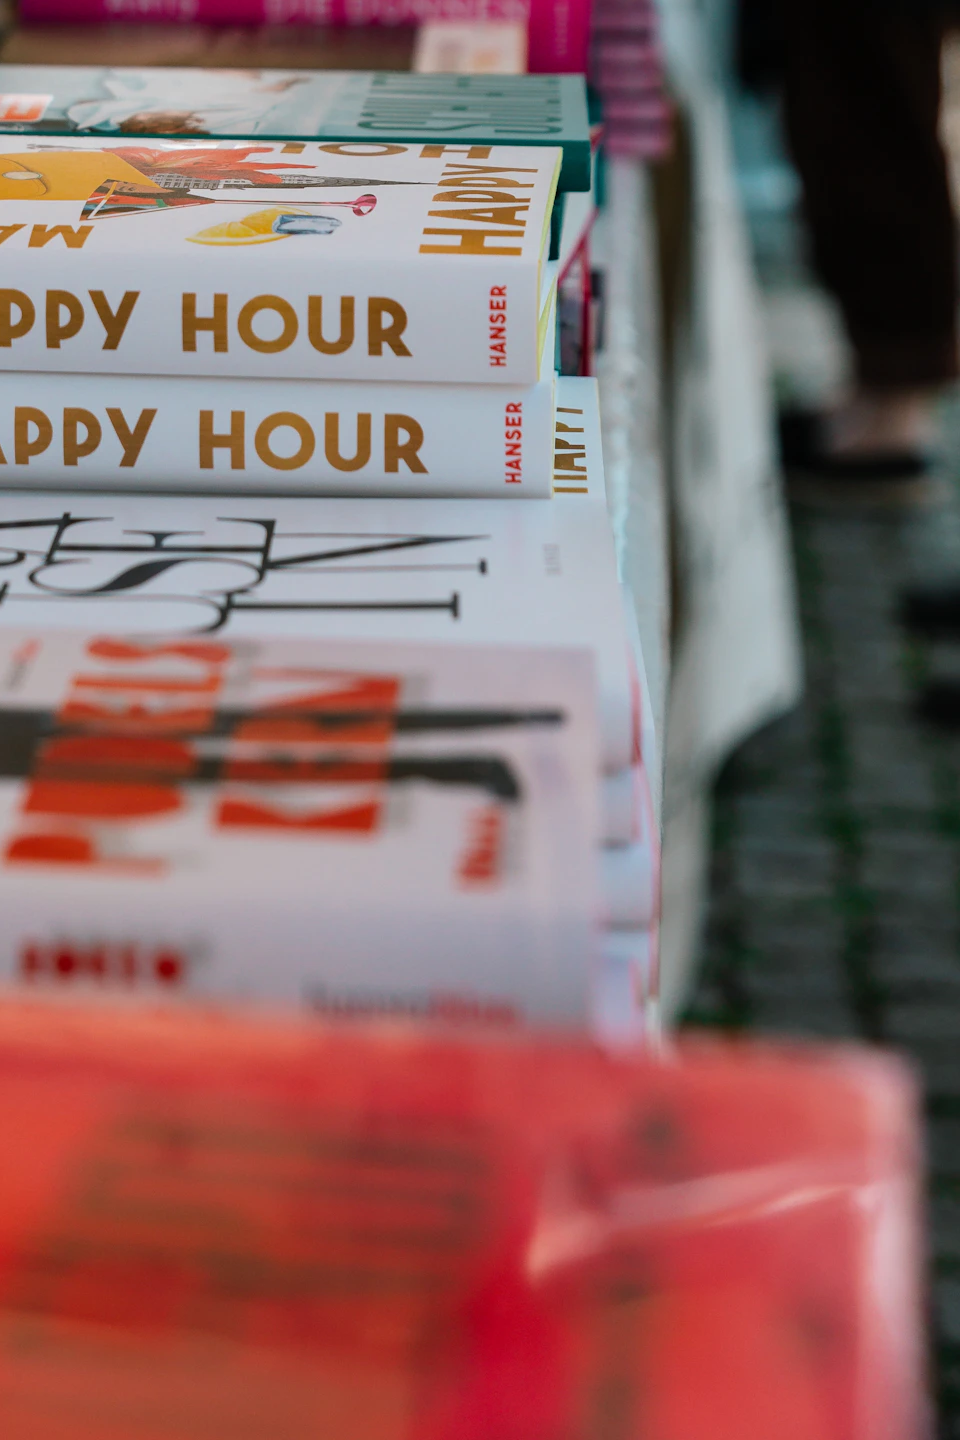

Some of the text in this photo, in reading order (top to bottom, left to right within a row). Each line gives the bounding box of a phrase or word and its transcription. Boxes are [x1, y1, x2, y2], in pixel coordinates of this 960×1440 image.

[419, 163, 538, 256] HAPPY
[181, 293, 413, 357] HOUR
[489, 285, 507, 367] HANSER
[198, 410, 430, 475] HOUR
[505, 402, 523, 484] HANSER
